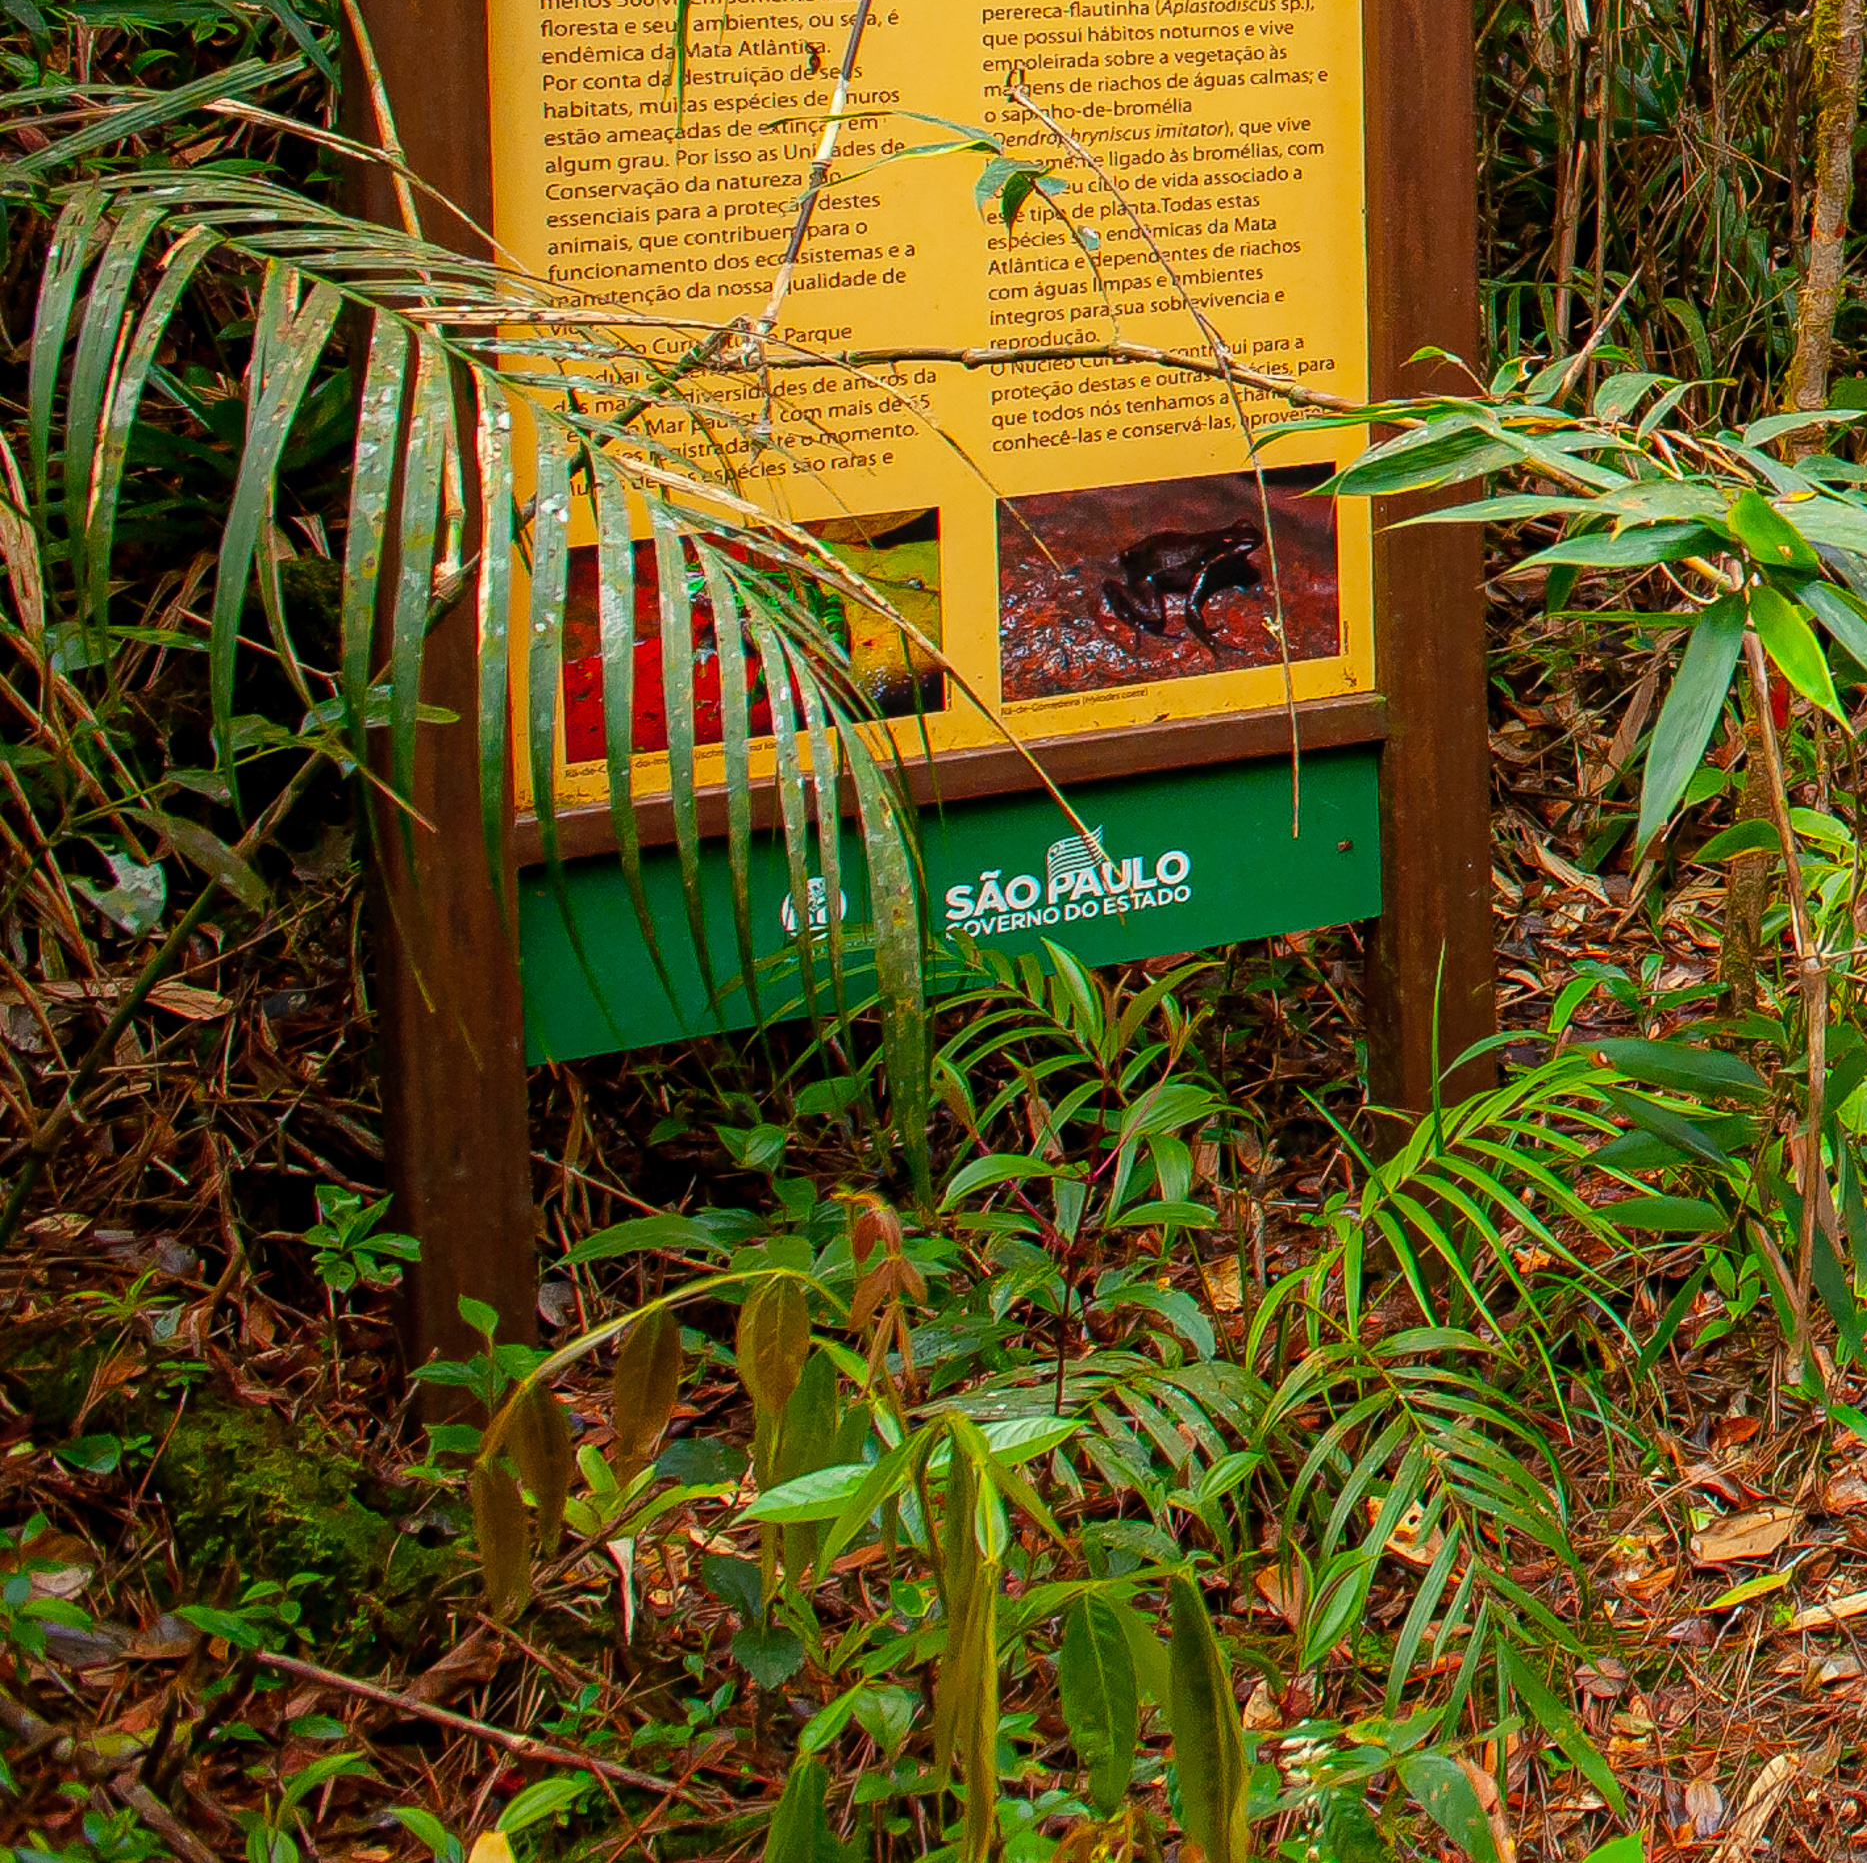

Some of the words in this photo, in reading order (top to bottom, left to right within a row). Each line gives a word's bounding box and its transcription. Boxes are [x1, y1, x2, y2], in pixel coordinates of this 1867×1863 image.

[540, 17, 618, 37] floresta
[692, 11, 804, 31] ambientes,
[981, 30, 1019, 49] que
[1023, 24, 1082, 47] possui
[1086, 21, 1155, 41] hábitos
[1158, 19, 1240, 38] noturnos
[1258, 16, 1294, 34] vive
[540, 44, 644, 64] endêmica
[1103, 46, 1155, 65] sobre
[1173, 42, 1264, 65] vegetação
[1268, 40, 1288, 58] às
[542, 73, 577, 91] Por
[582, 70, 642, 89] conta
[1069, 74, 1092, 92] de
[1097, 71, 1162, 90] riachos
[1166, 69, 1189, 87] de
[1192, 68, 1245, 89] águas
[1249, 65, 1313, 83] calmas;
[542, 98, 633, 118] habitats,
[712, 90, 798, 113] espécies
[543, 126, 601, 145] estão
[1153, 116, 1234, 137] imitator),
[1237, 118, 1272, 137] que
[1275, 113, 1311, 131] vive
[544, 154, 612, 175] algum
[616, 153, 670, 172] grau.
[713, 145, 752, 163] isso
[1108, 145, 1165, 168] ligado
[1169, 144, 1189, 161] às
[1192, 139, 1283, 160] bromélias,
[1286, 139, 1324, 155] com
[544, 175, 680, 200] Conservação
[715, 170, 802, 189] natureza
[1134, 171, 1158, 188] de
[1161, 168, 1199, 187] vida
[1202, 163, 1284, 184] associado
[545, 204, 650, 227] essenciais
[655, 203, 701, 223] para
[818, 189, 881, 208] destes
[1071, 199, 1094, 217] de
[1216, 189, 1260, 208] estas
[1233, 212, 1277, 231] Mata
[546, 232, 633, 254] animais,
[637, 231, 679, 251] que
[987, 252, 1069, 274] Atlântica
[1238, 235, 1302, 256] riachos
[547, 253, 708, 281] funcionamento
[712, 250, 750, 268] dos
[716, 276, 773, 294] nossa
[987, 283, 1028, 299] com
[1032, 278, 1088, 299] águas
[1069, 302, 1110, 322] para
[1112, 299, 1145, 315] sua
[783, 321, 853, 341] Parque
[1252, 336, 1291, 357] para
[990, 378, 1073, 405] proteção
[1077, 373, 1136, 393] destas
[1297, 357, 1335, 377] para
[779, 401, 819, 418] com
[828, 396, 872, 416] mais
[990, 410, 1027, 430] que
[1031, 403, 1085, 422] todos
[1089, 399, 1121, 417] nós
[1125, 392, 1215, 414] tenhamos
[991, 426, 1103, 452] conhecê-las
[1121, 414, 1236, 439] conservá-las,
[945, 869, 1042, 921] SÃO
[1046, 850, 1192, 906] PAULO
[1063, 900, 1099, 922] DO
[1103, 885, 1192, 916] ESTADO
